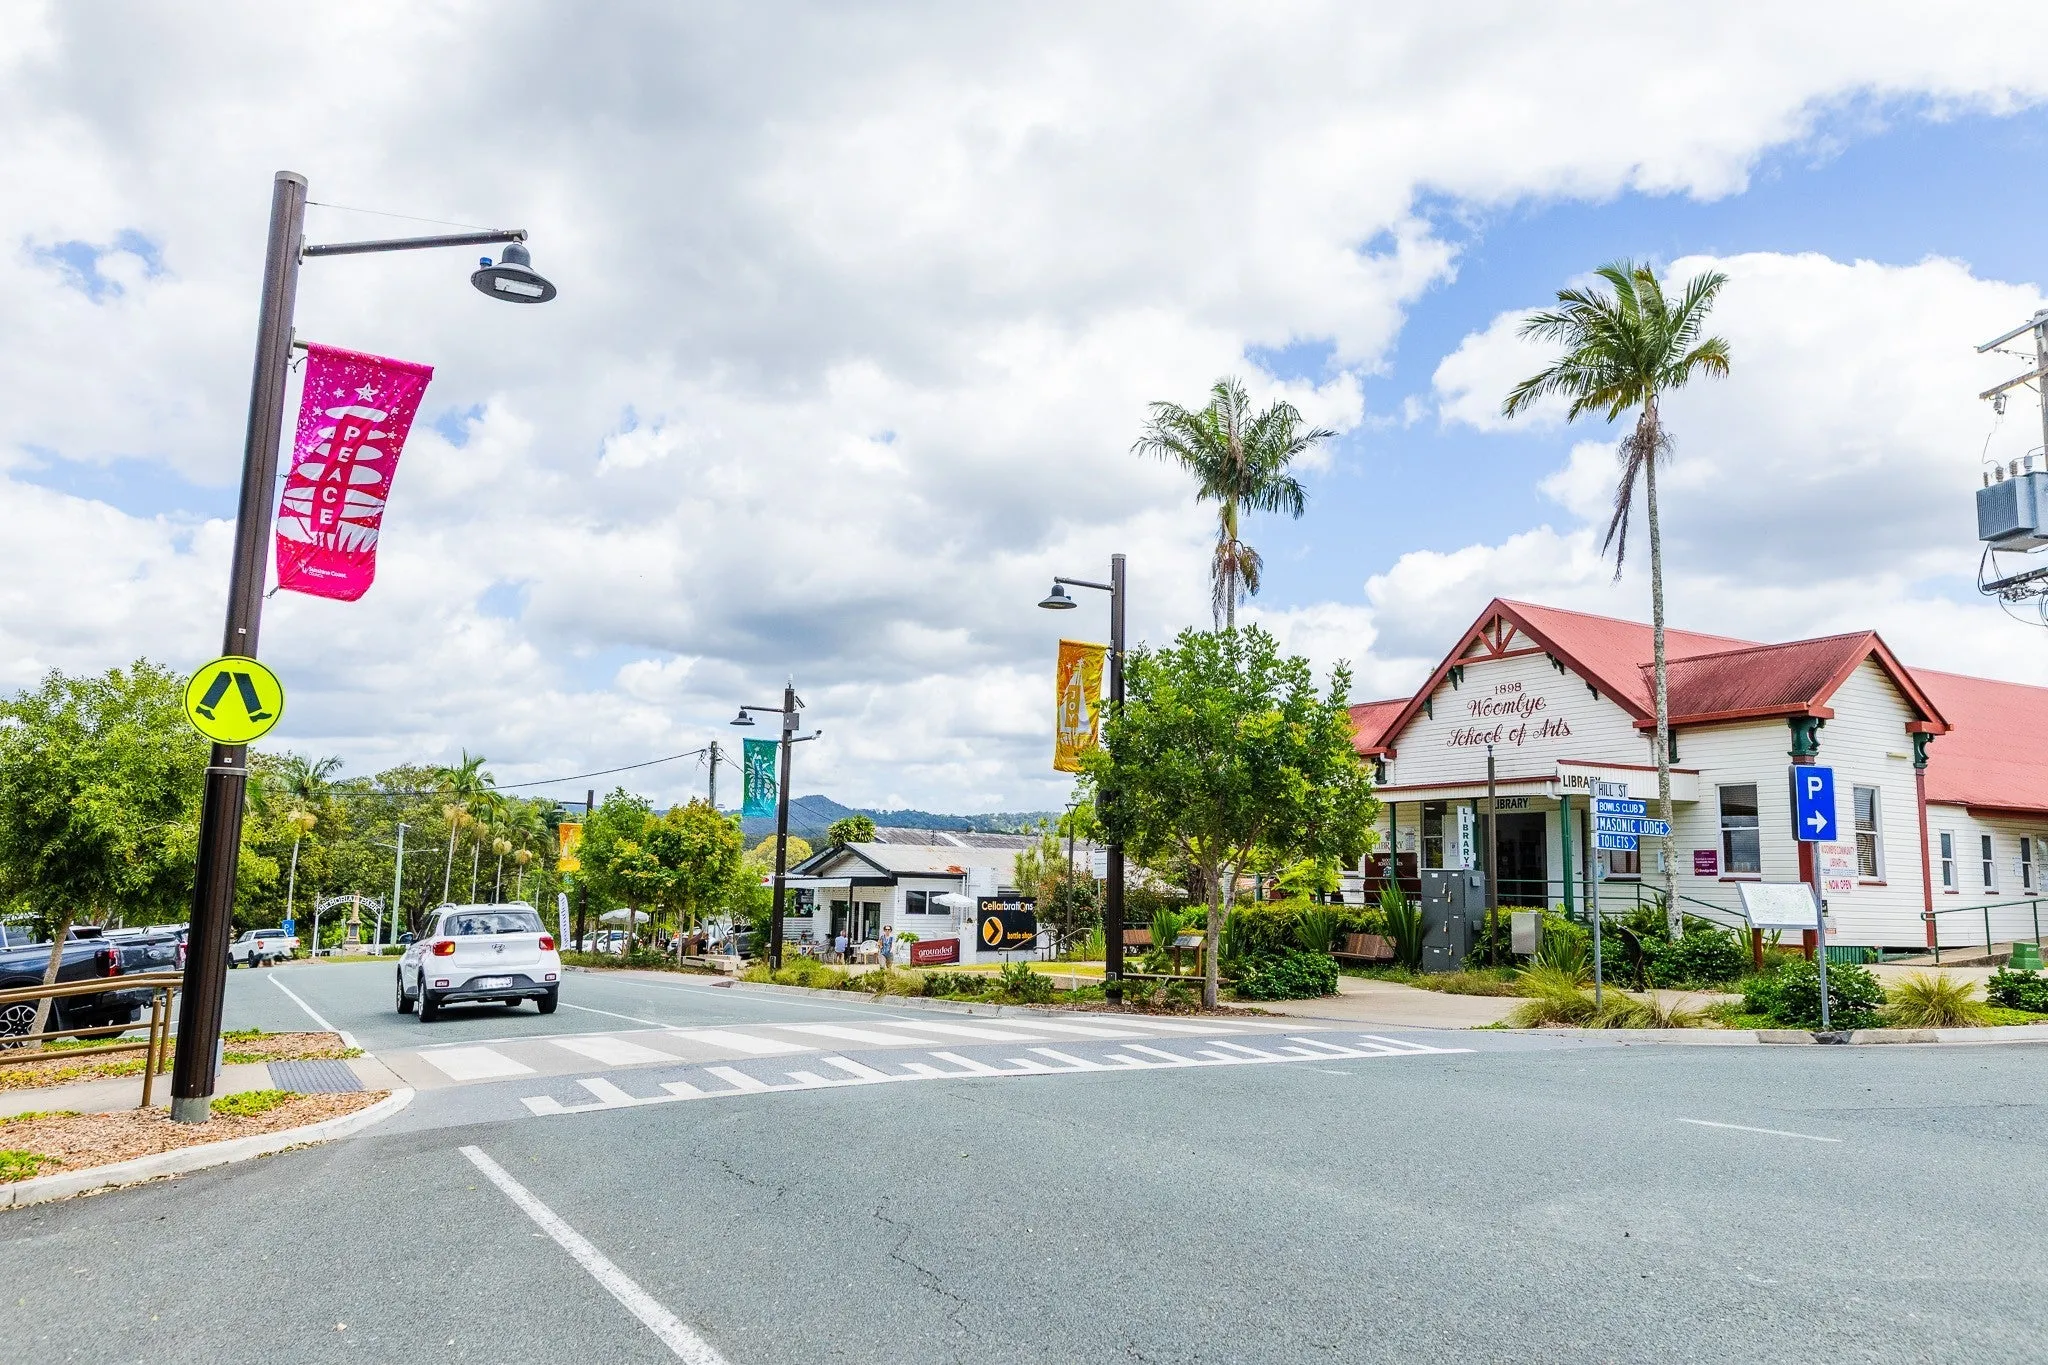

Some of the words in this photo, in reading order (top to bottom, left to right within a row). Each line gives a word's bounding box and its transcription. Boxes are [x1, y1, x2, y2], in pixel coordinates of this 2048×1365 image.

[319, 425, 361, 525] PEACE
[1494, 682, 1522, 695] 1898
[1467, 692, 1547, 719] Woombye
[1446, 723, 1503, 747] School
[1508, 723, 1526, 747] of
[1532, 717, 1573, 739] Arts
[1598, 783, 1614, 797] HILL
[1618, 784, 1627, 798] ST
[1807, 776, 1823, 800] P
[1599, 803, 1620, 812] BOWLS
[1622, 803, 1639, 813] CLUB
[1600, 817, 1636, 833] MASONIC
[1640, 820, 1665, 835] LODGE
[1462, 808, 1470, 864] LIBRARY
[1601, 834, 1629, 849] TOILETS
[1828, 880, 1840, 889] NOW
[1840, 880, 1852, 889] OPEN
[1007, 931, 1021, 940] bottle
[1022, 931, 1033, 940] shop
[918, 946, 953, 960] grounded
